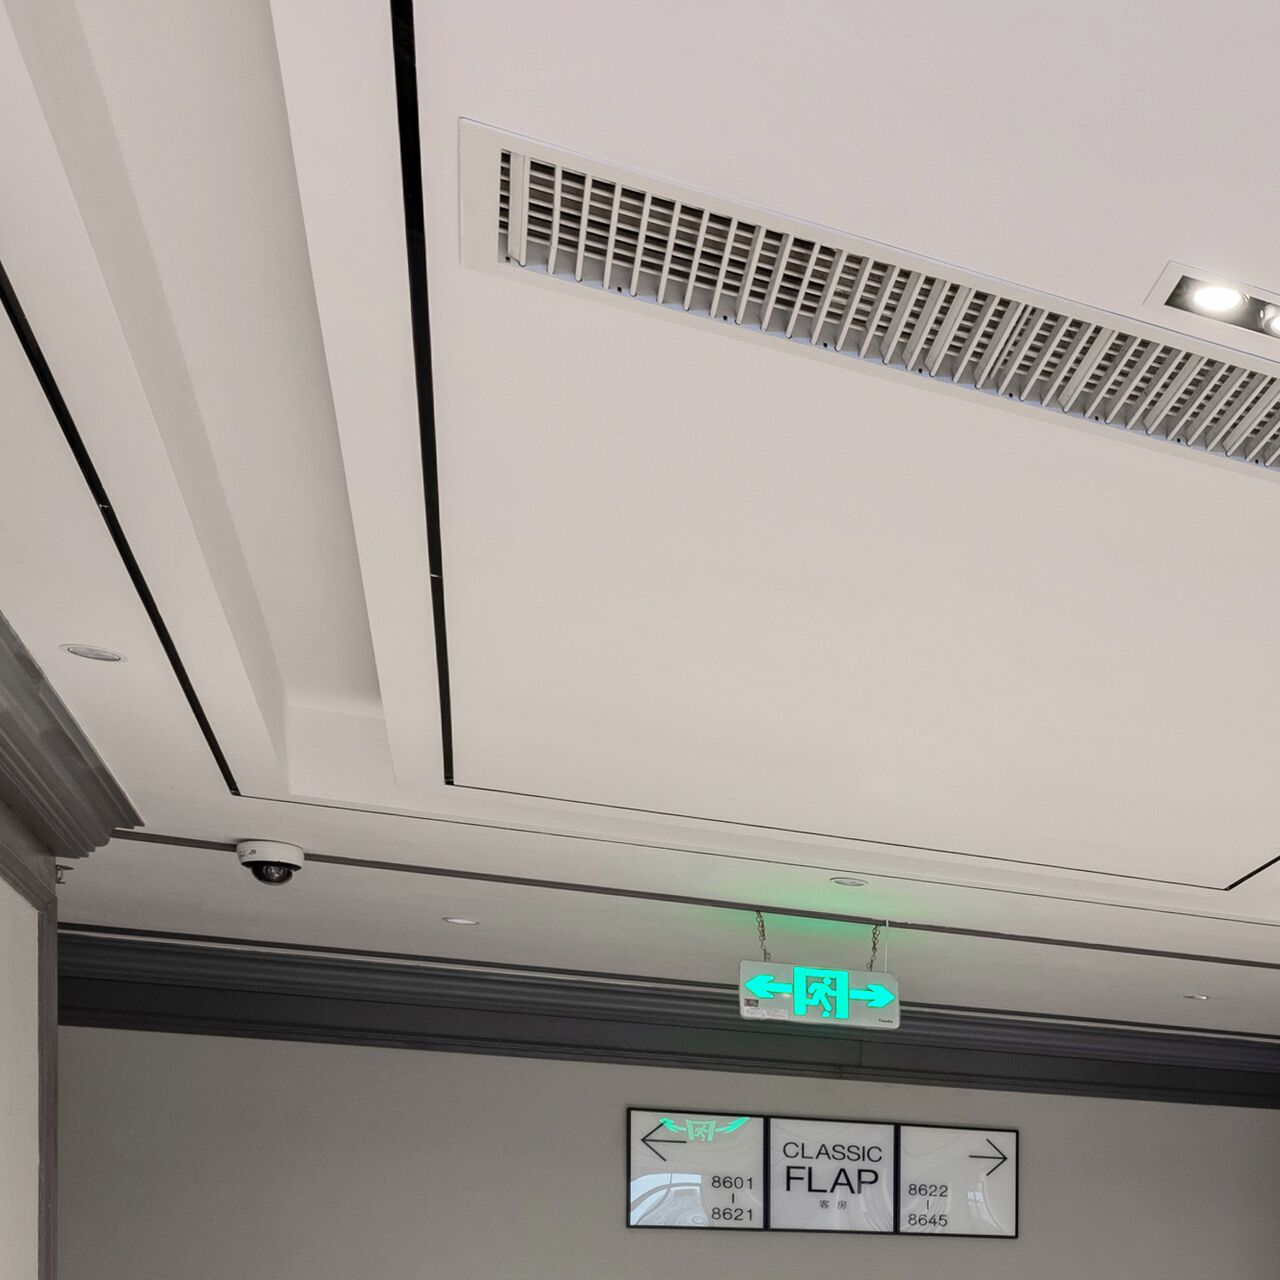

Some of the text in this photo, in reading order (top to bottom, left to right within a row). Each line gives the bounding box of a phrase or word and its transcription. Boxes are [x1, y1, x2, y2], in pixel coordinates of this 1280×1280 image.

[783, 1141, 882, 1162] CLASSIC
[711, 1175, 753, 1190] 8601
[785, 1165, 879, 1194] FLAP
[908, 1183, 948, 1198] 8622
[711, 1207, 753, 1221] 8621
[908, 1213, 948, 1227] 8645
